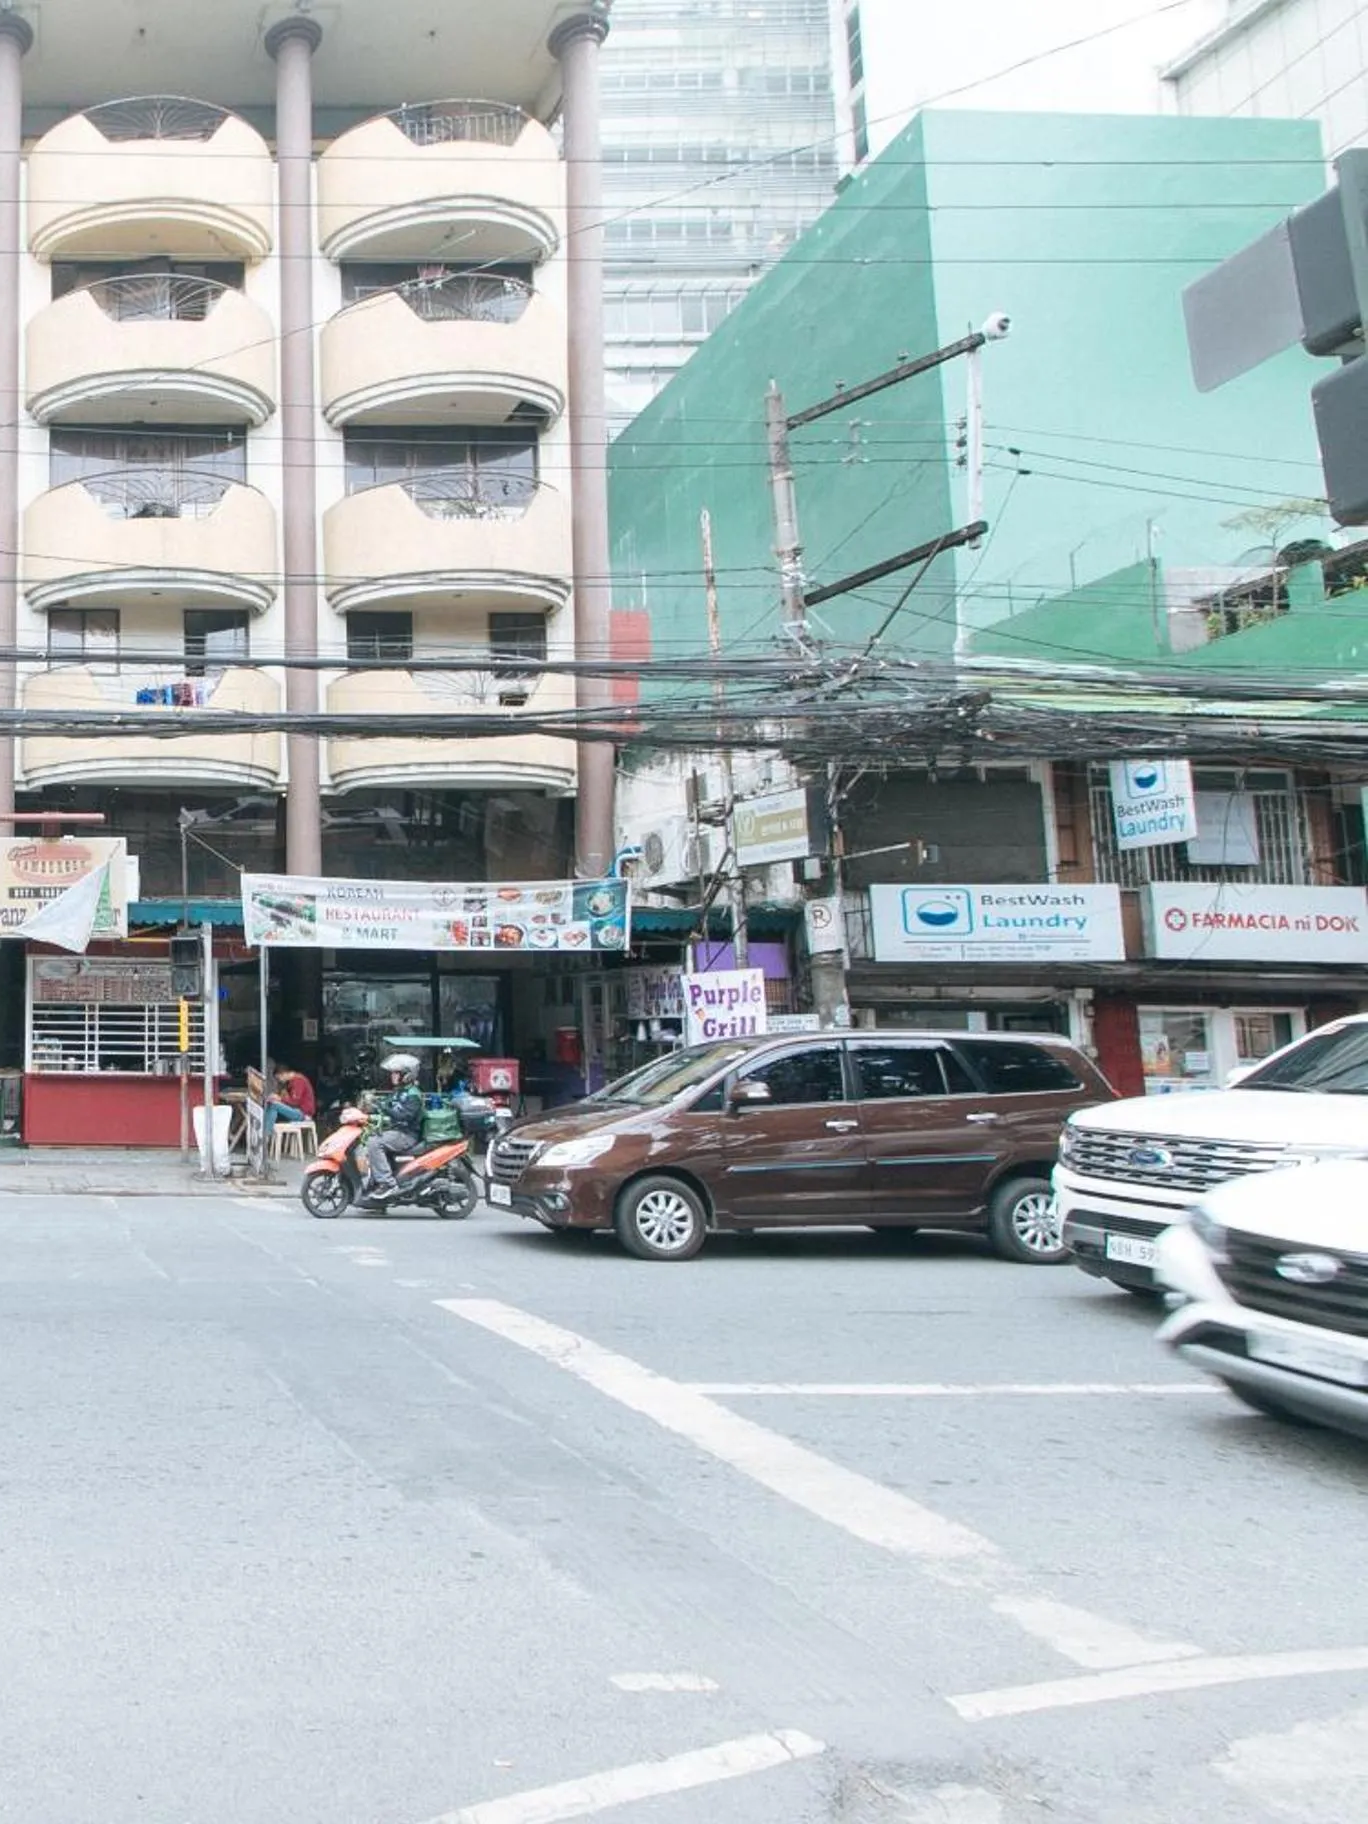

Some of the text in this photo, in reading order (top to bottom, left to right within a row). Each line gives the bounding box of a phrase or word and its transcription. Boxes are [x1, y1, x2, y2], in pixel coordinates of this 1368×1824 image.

[1117, 795, 1185, 818] BestWash
[1118, 813, 1186, 838] Laundry
[326, 885, 385, 900] KOREAN
[980, 893, 1086, 907] BestWash
[325, 906, 421, 922] RESTAURANT
[983, 912, 1088, 931] Laundry
[1192, 912, 1360, 932] FARMACIA ni DOK
[356, 926, 399, 941] MART
[688, 980, 762, 1011] Purple
[702, 1015, 757, 1038] Grill
